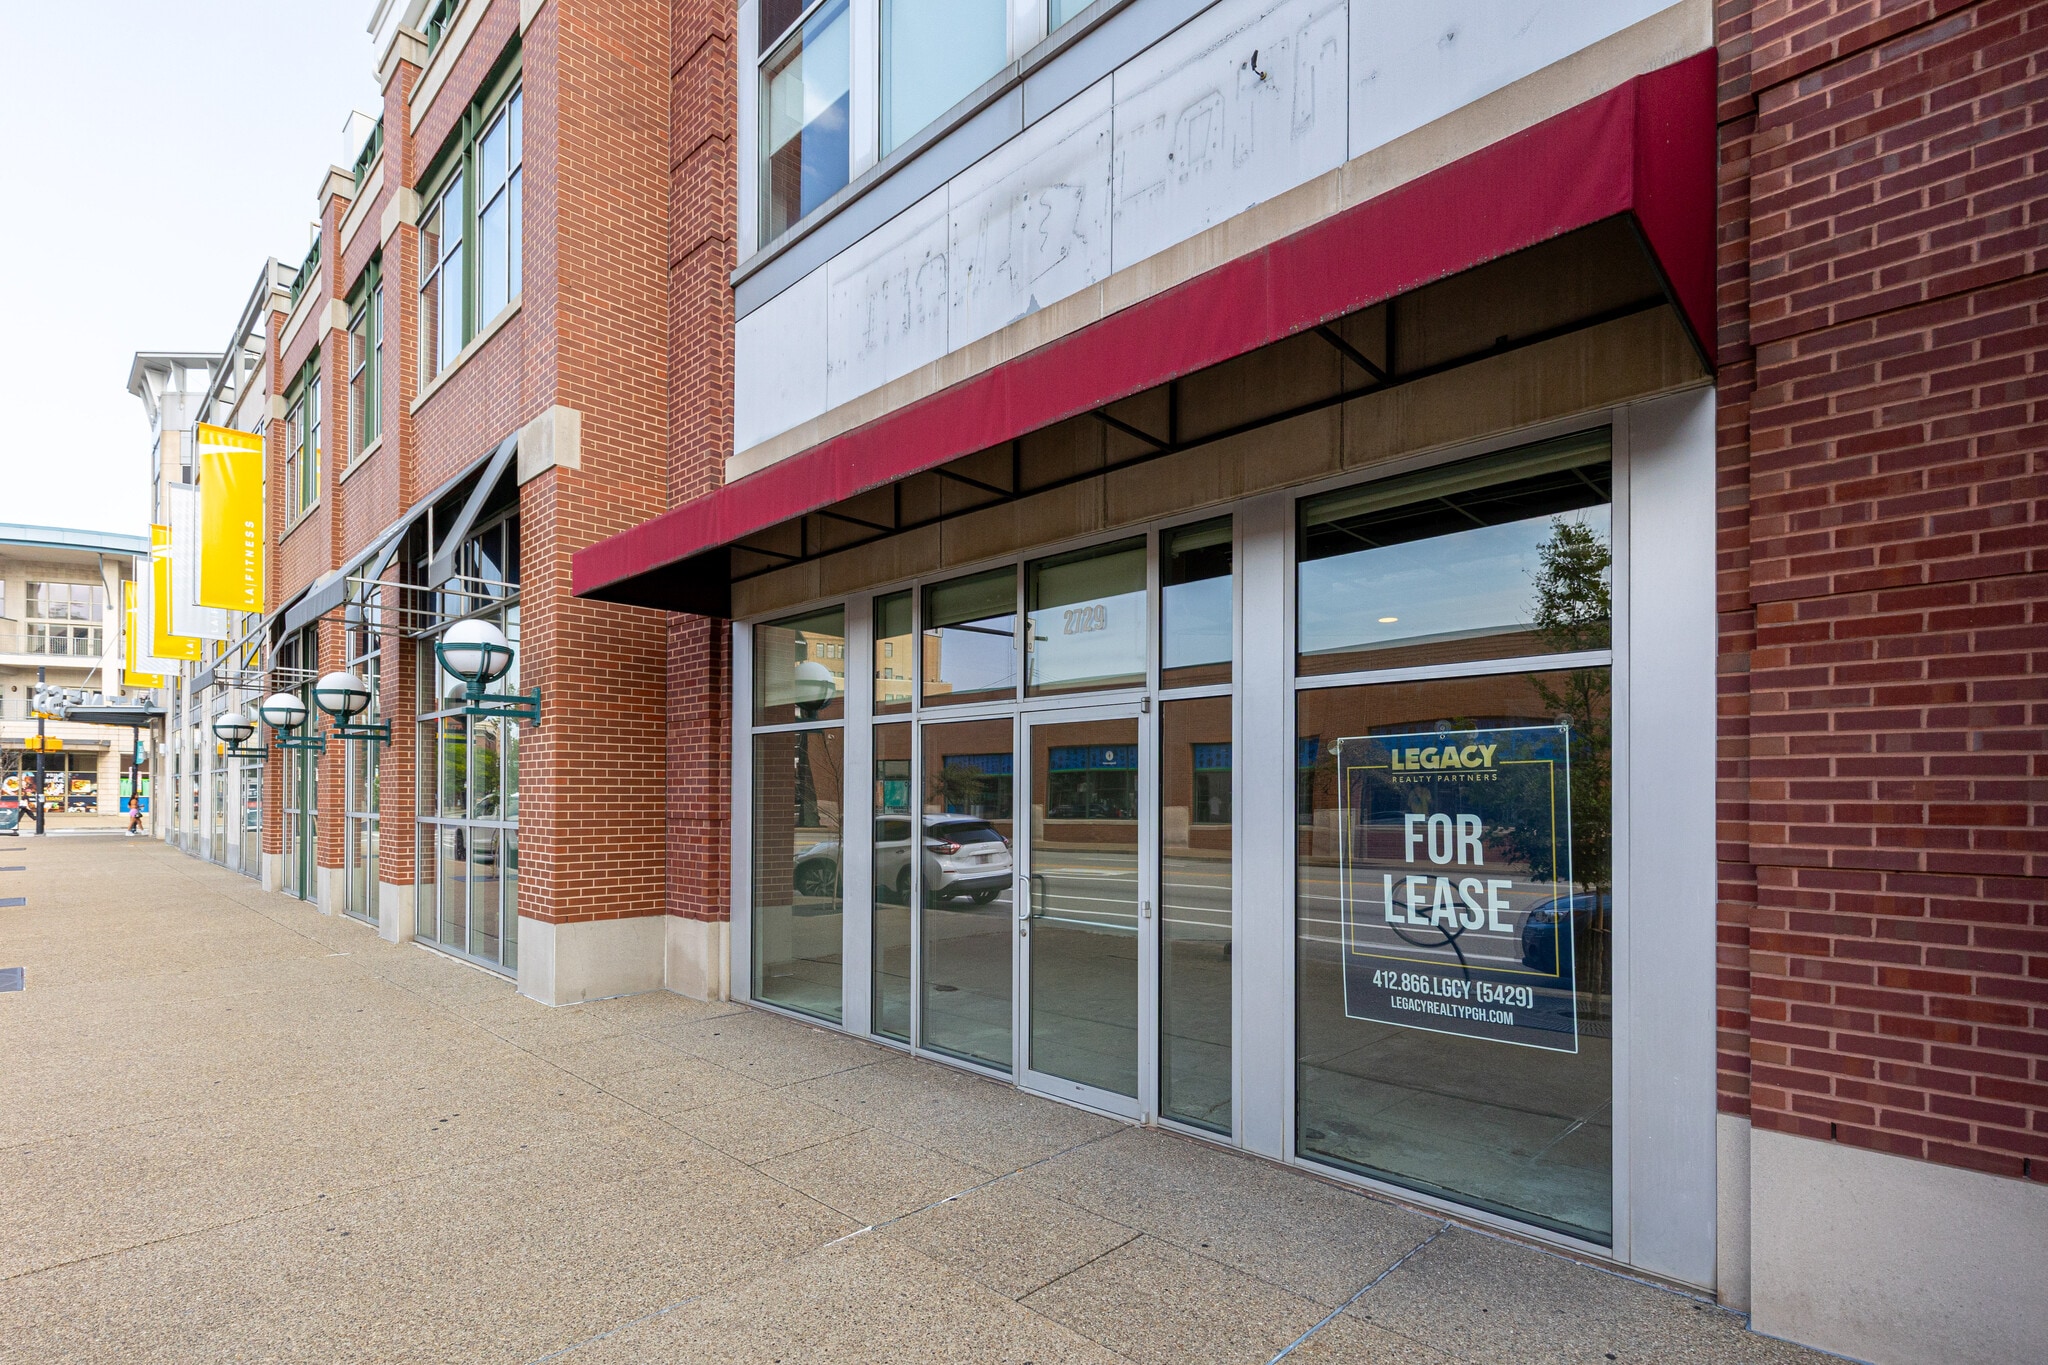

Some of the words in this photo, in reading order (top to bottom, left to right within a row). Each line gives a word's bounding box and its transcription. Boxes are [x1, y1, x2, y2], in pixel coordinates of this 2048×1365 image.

[1063, 604, 1107, 635] 2729
[1391, 744, 1498, 770] LEGACY
[1392, 775, 1432, 783] REALTY
[1437, 773, 1498, 782] PARTNERS
[1404, 813, 1484, 866] FOR
[1383, 874, 1514, 933] LEASE
[1372, 969, 1471, 1000] 412.866.LGCY
[1476, 981, 1534, 1009] (5429)
[1391, 995, 1514, 1025] LEGACYREALTYPGH.COM
